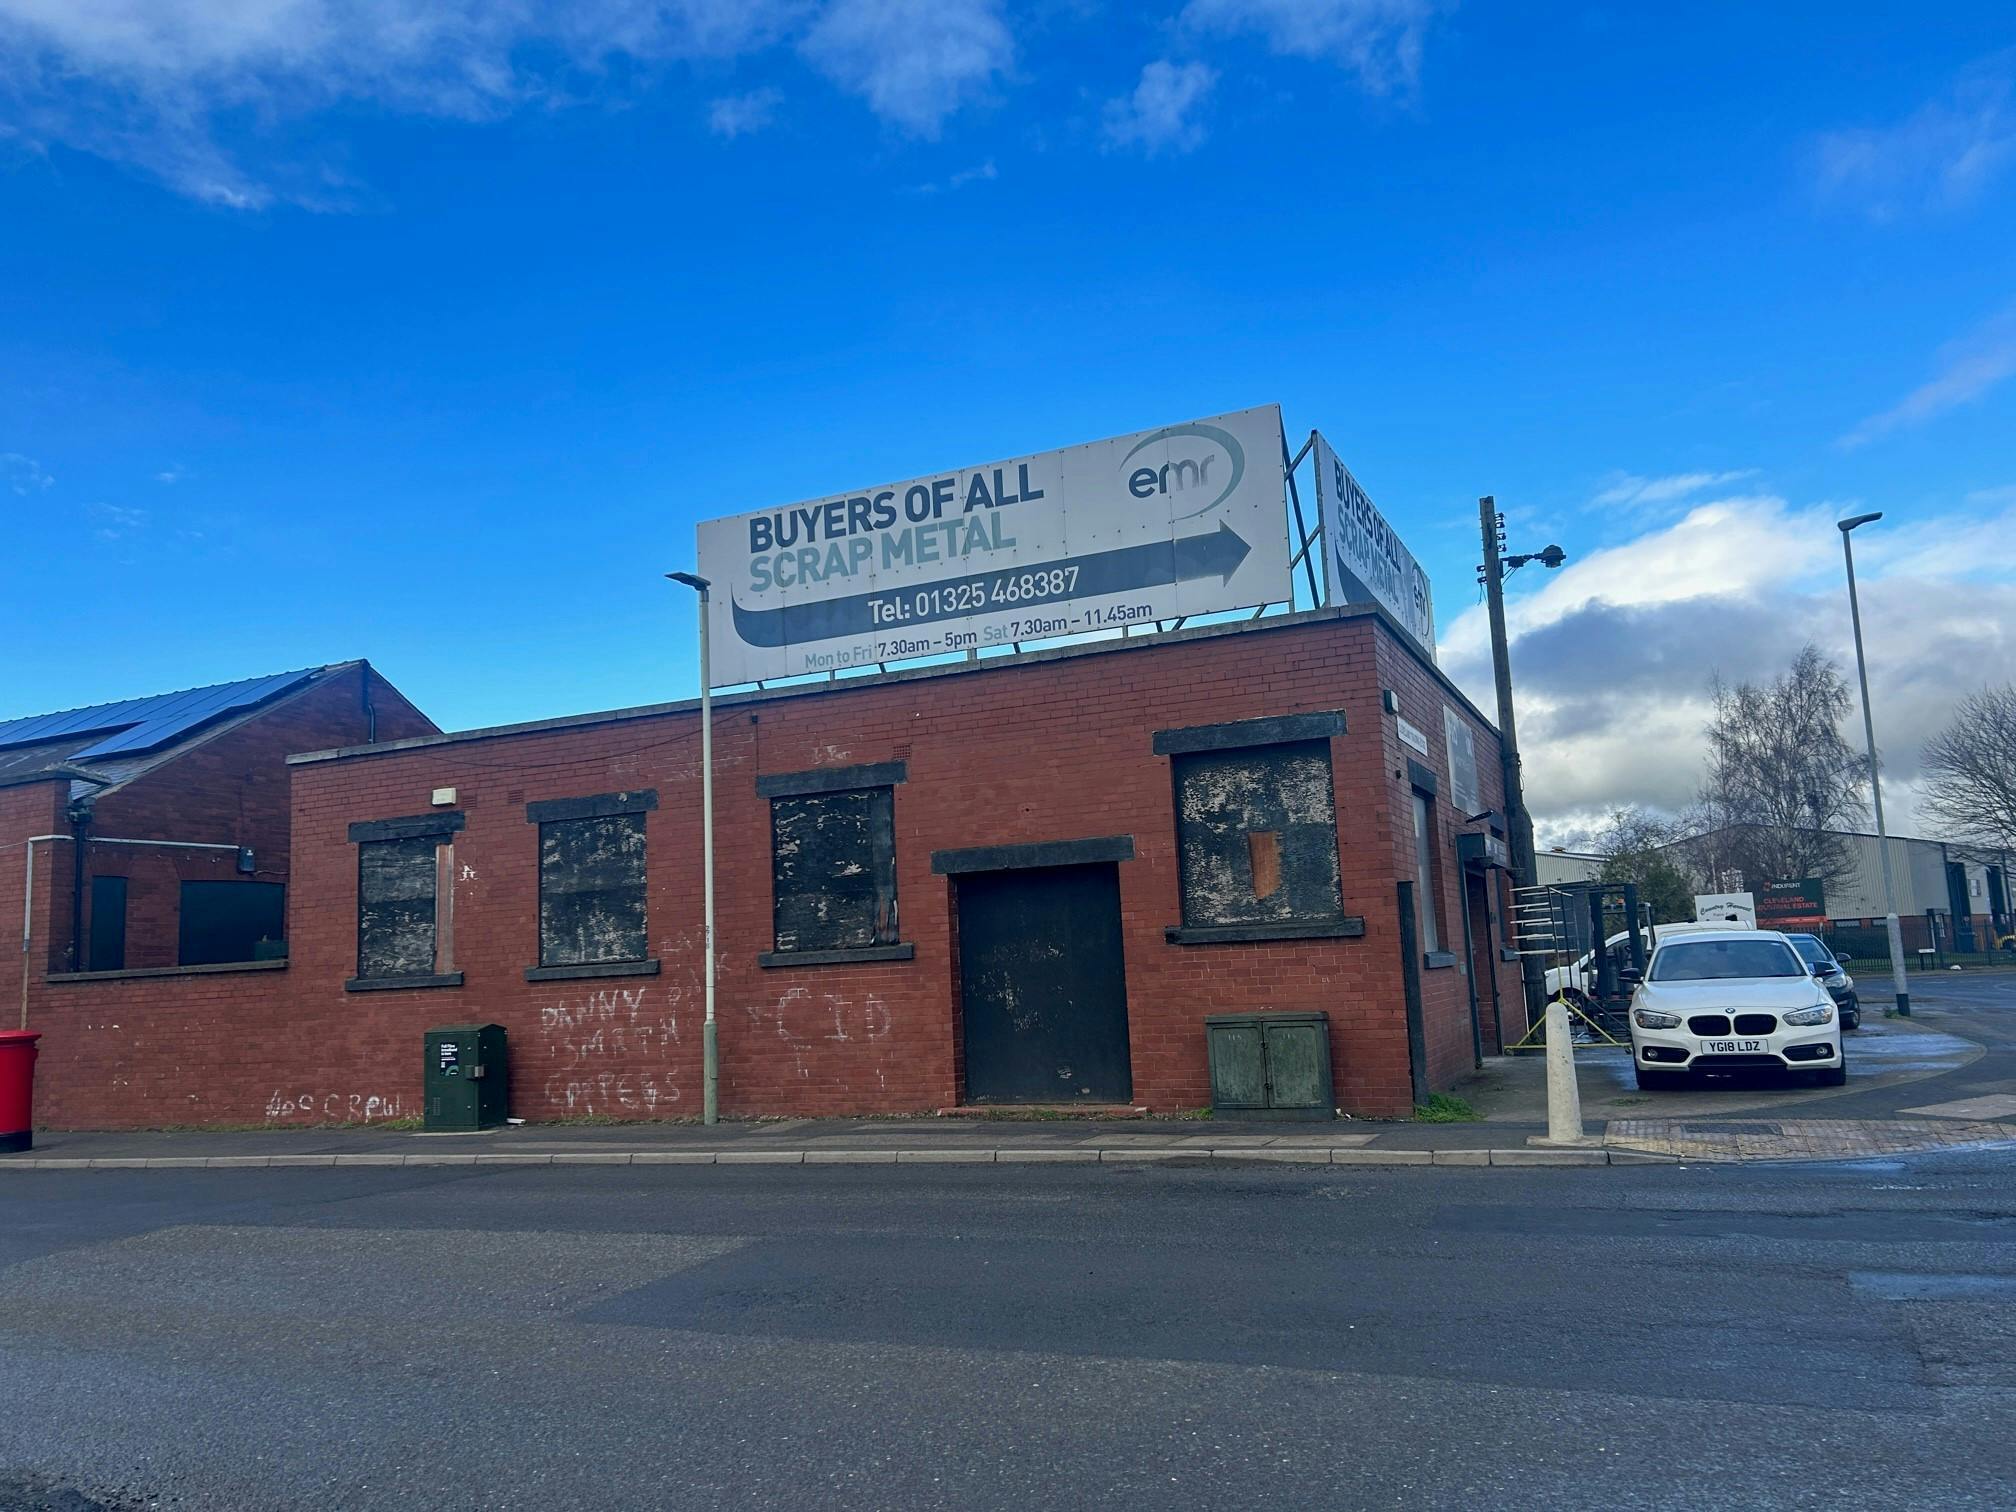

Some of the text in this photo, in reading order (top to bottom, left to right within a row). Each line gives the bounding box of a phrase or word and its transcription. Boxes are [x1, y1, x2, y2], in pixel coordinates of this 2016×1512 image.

[750, 463, 1044, 553] BUYERS OF ALL
[1128, 454, 1215, 498] emr
[750, 511, 1016, 592] SCRAP METAL
[1334, 458, 1402, 574] BUYERS OF ALL
[1338, 503, 1398, 603] SCRAP METAL
[868, 566, 1079, 624] Tel: 01325 468387
[804, 652, 834, 669] Mon
[836, 650, 850, 665] to
[853, 645, 872, 663] Fri
[878, 639, 930, 657] 7.30am
[945, 631, 977, 650] 5pm
[983, 625, 1009, 641] Sat
[1011, 616, 1067, 637] 7.30am
[1084, 603, 1153, 626] 11.45am
[1709, 1041, 1760, 1052] YG18 LDZ
